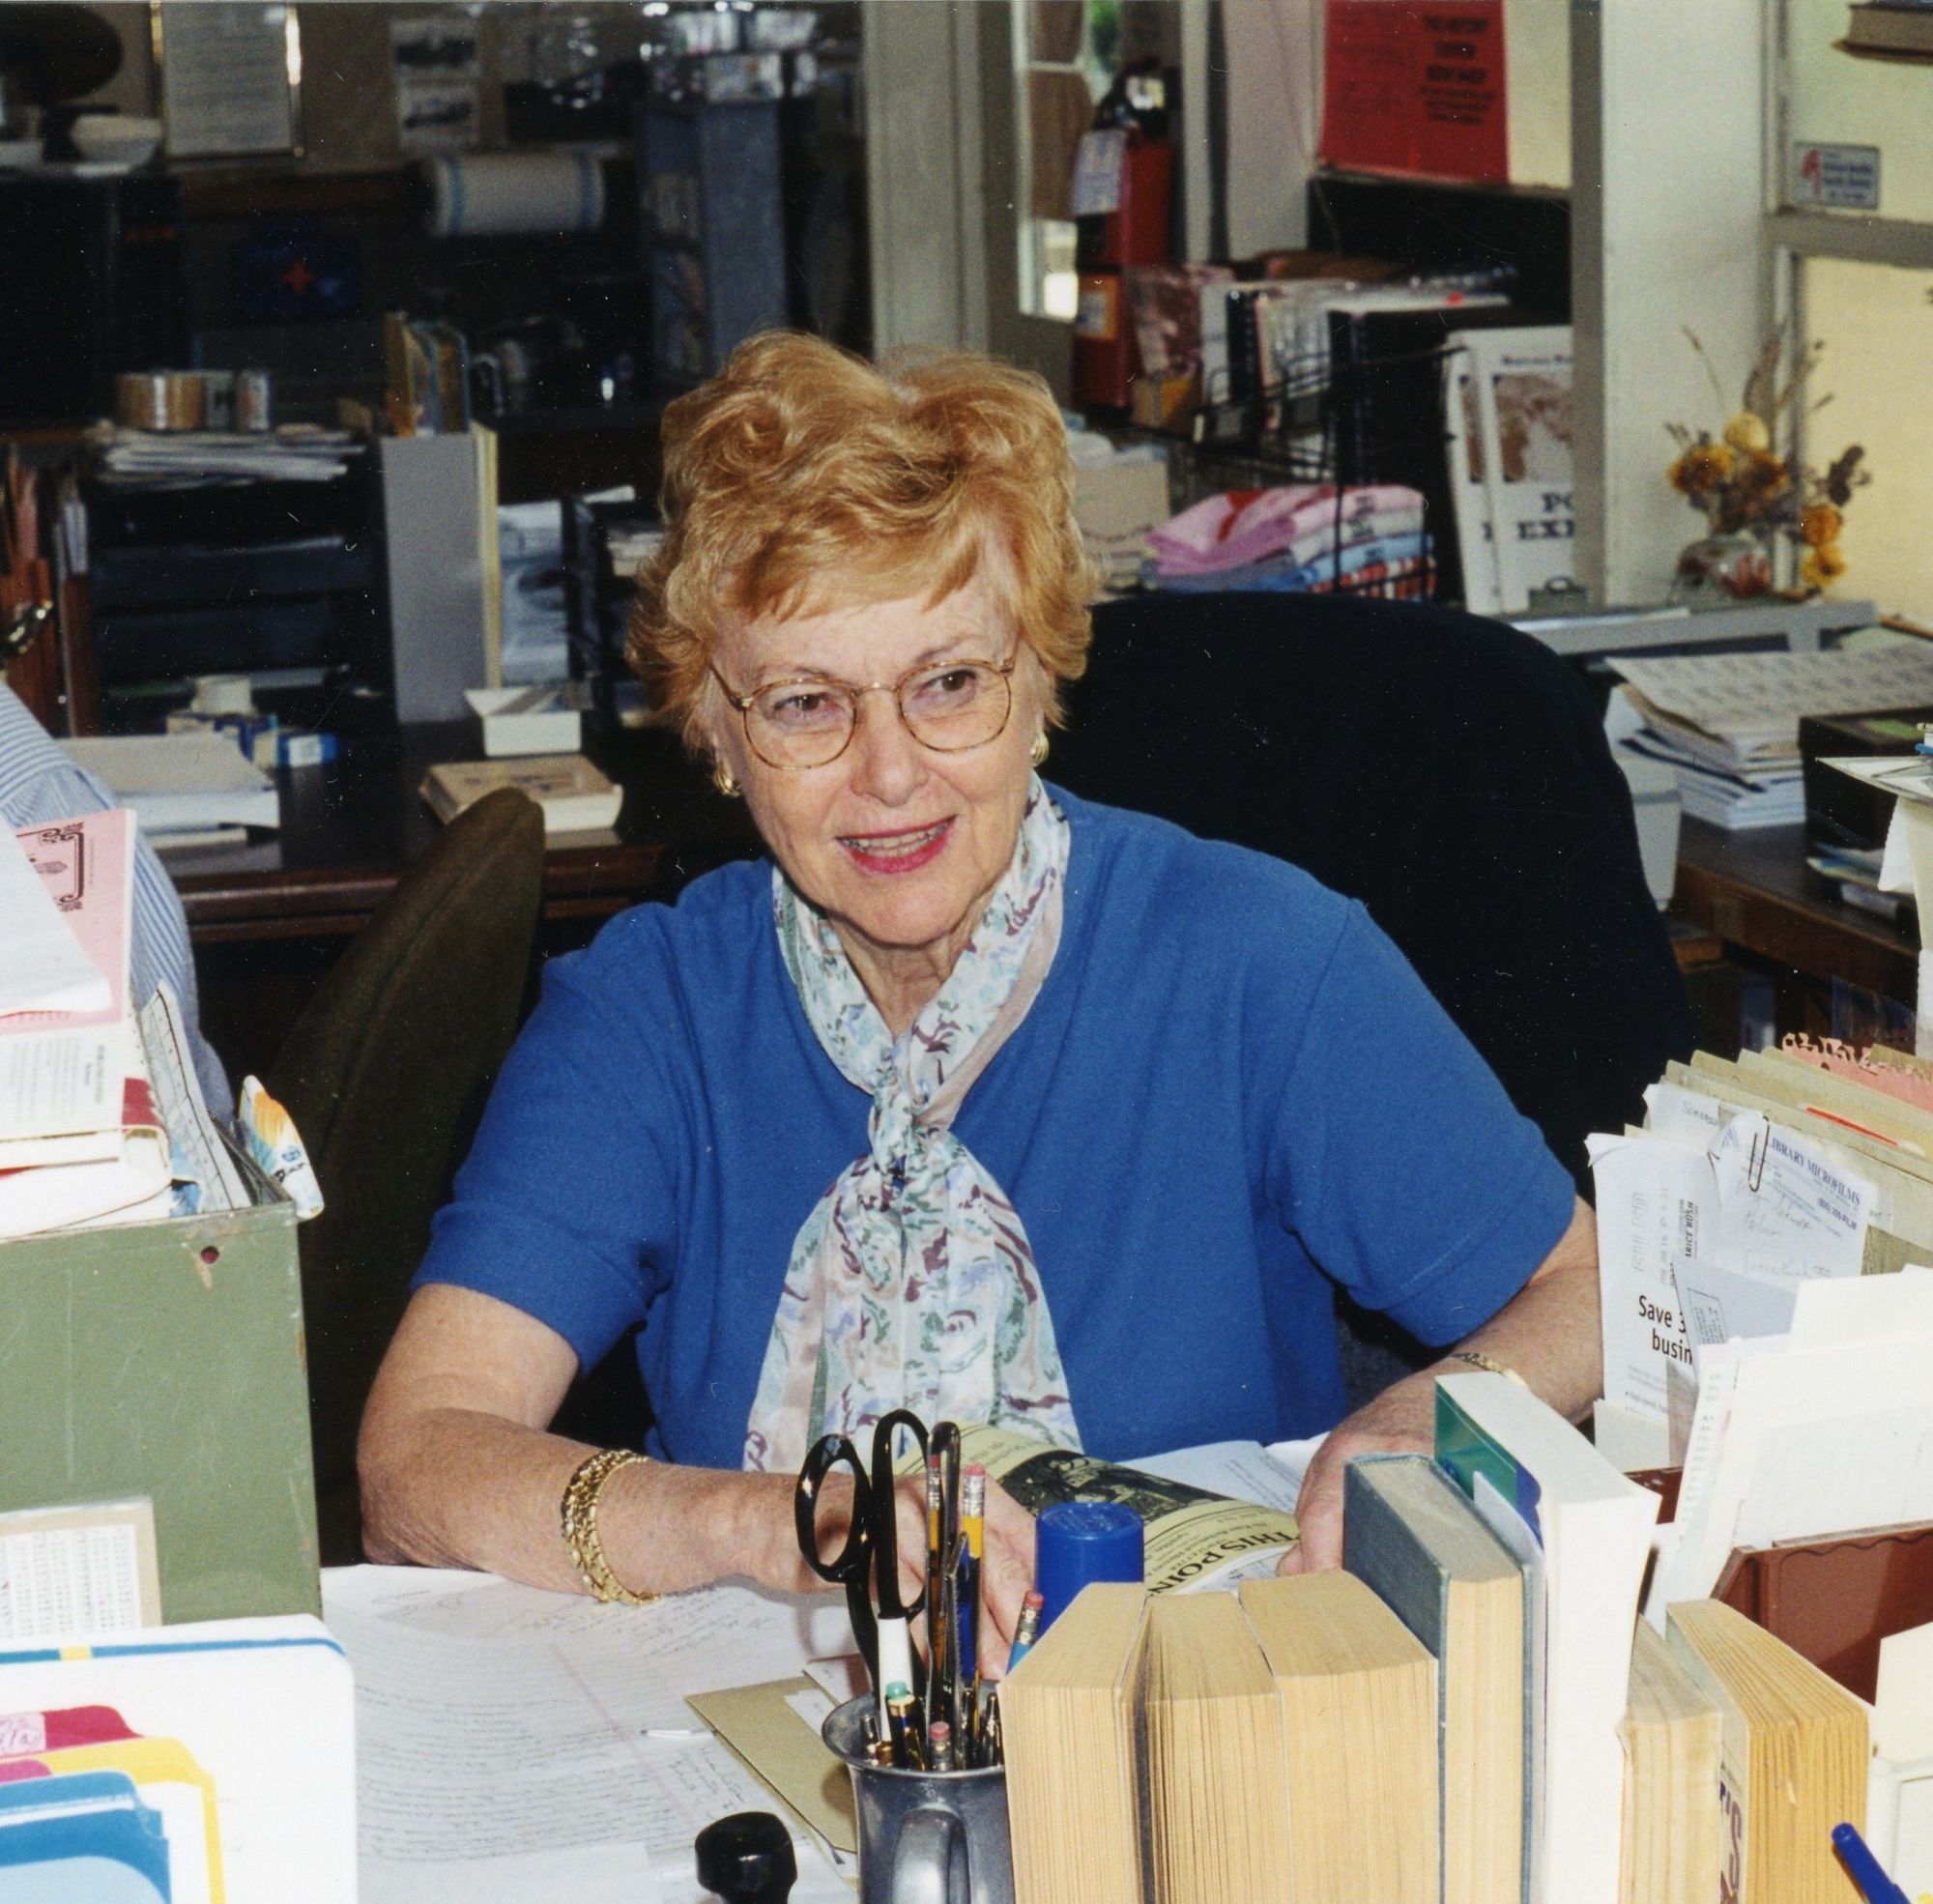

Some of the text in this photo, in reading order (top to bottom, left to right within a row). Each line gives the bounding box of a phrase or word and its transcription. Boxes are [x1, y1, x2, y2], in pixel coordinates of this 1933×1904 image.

[1806, 1159, 1861, 1207] MICROFILMS
[1638, 1294, 1673, 1329] Save
[1147, 1551, 1225, 1598] POIN
